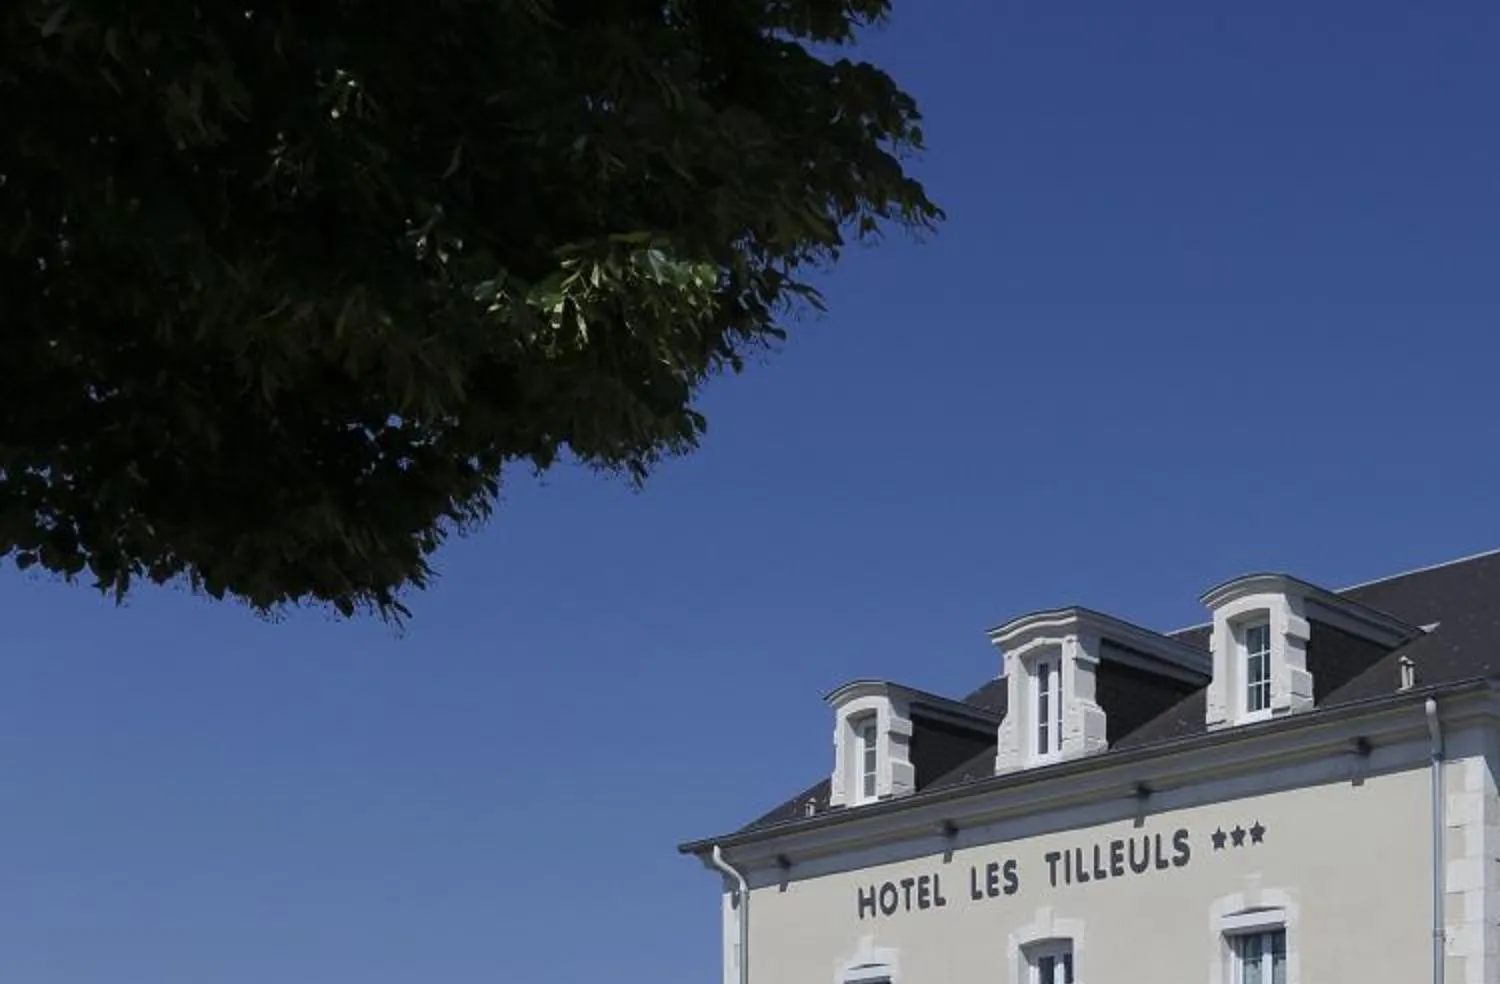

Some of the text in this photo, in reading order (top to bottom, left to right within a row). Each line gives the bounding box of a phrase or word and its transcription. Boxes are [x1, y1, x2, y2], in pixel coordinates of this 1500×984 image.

[857, 828, 1191, 920] HOTEL LES TILLEULS
